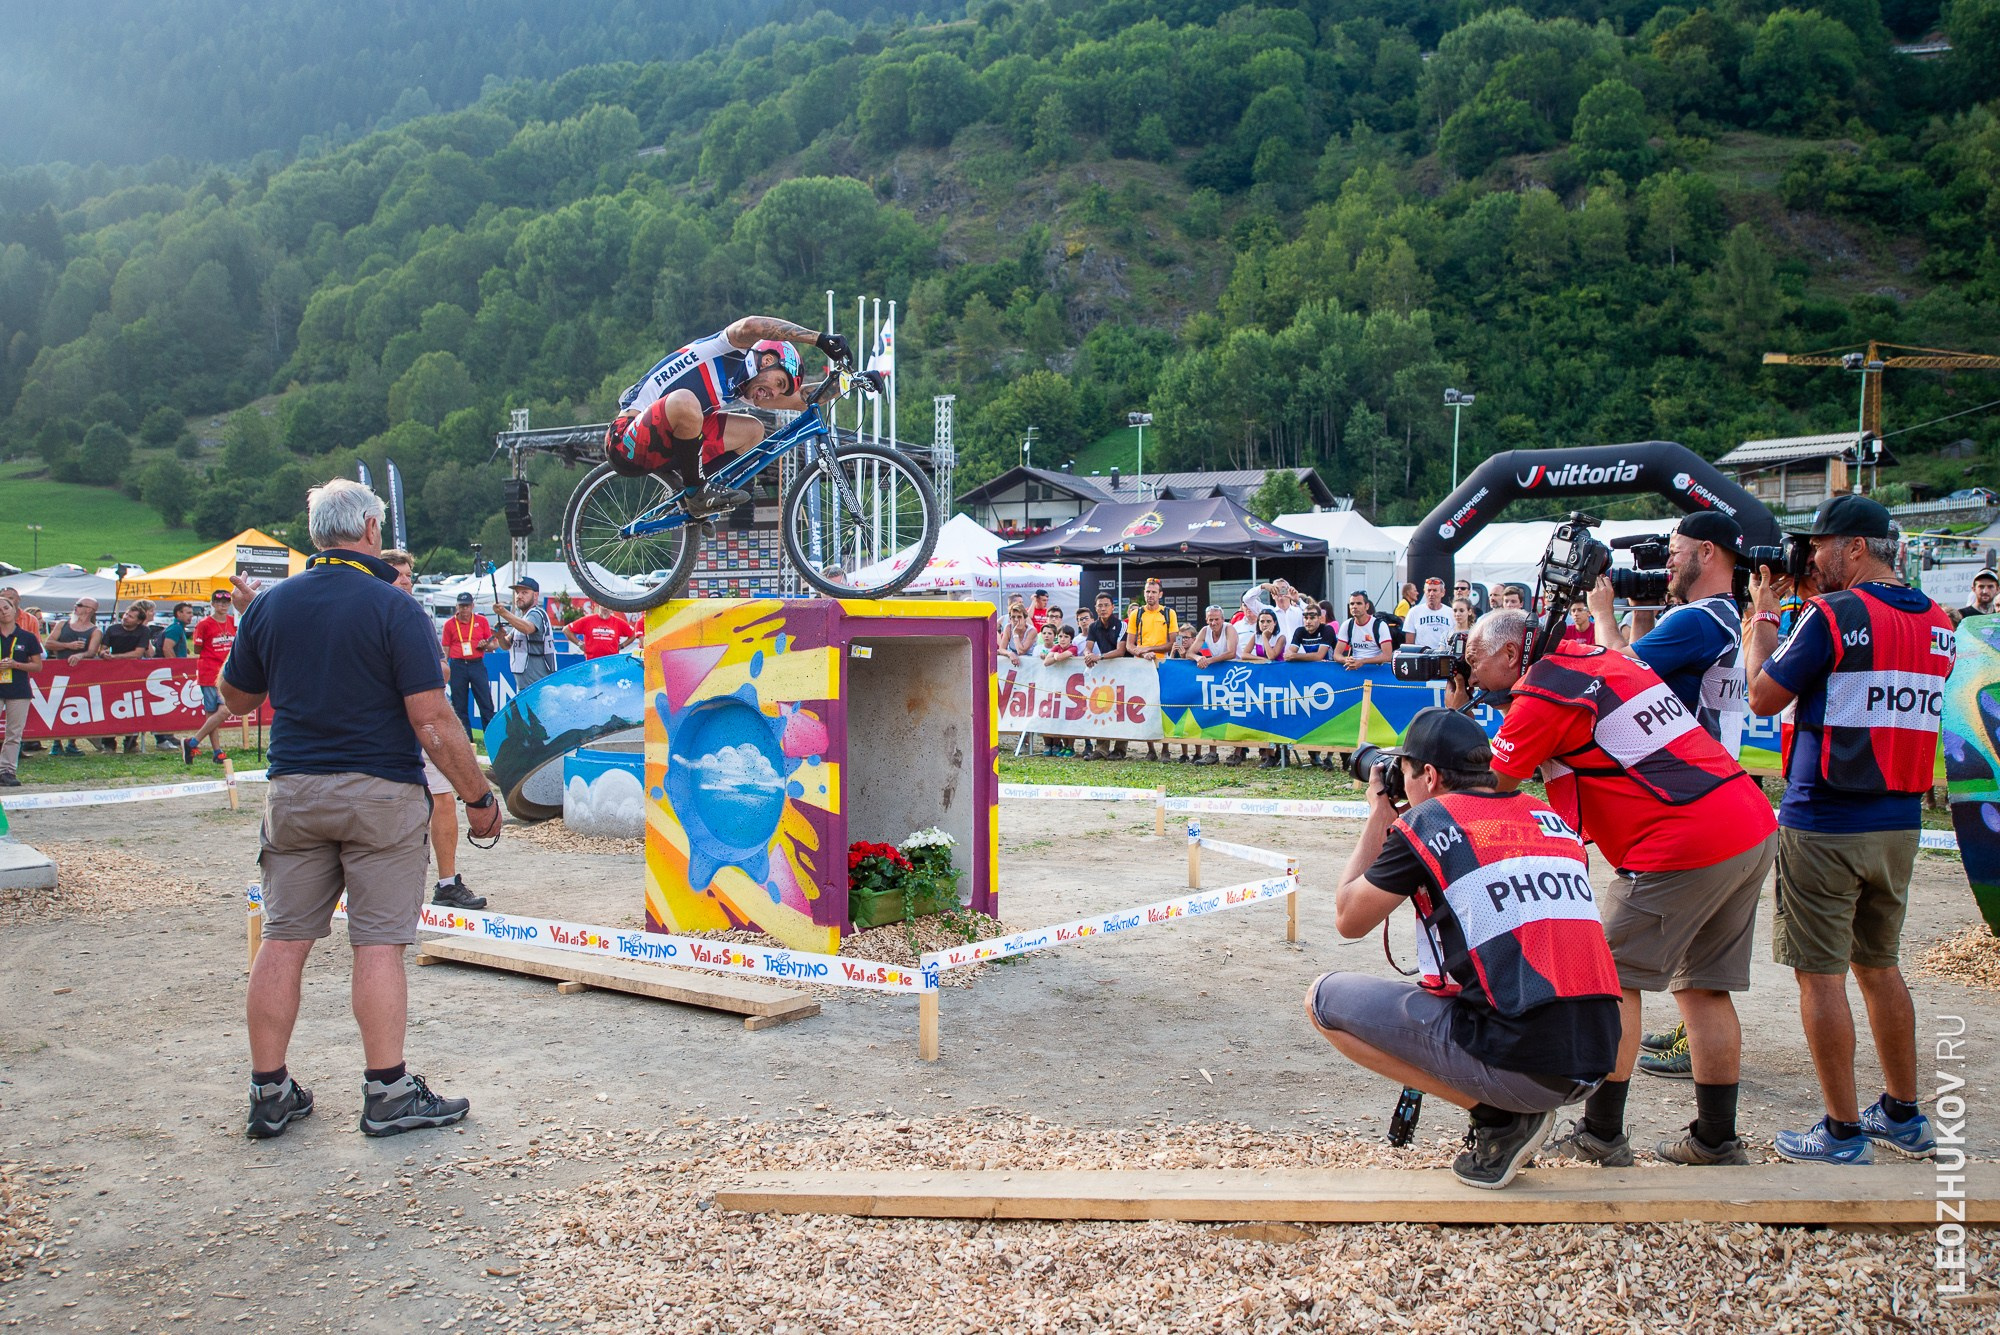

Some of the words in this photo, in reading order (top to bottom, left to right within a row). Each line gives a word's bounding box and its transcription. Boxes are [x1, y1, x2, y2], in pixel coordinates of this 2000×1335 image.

[653, 351, 700, 388] FRANCE
[1546, 460, 1639, 487] vittoria
[1453, 486, 1489, 521] GRAPHENE
[1690, 491, 1711, 508] PLUS
[1695, 485, 1737, 517] GRAPHENE
[1459, 508, 1477, 527] PLUS
[124, 583, 152, 597] ZAETA
[171, 581, 201, 595] ZAETA
[1420, 616, 1450, 626] DIESEL
[1525, 631, 1533, 652] EOS
[29, 675, 105, 730] Val
[110, 690, 145, 719] di
[998, 669, 1035, 719] Val
[1038, 691, 1061, 719] di
[1065, 673, 1147, 724] Sole
[1195, 675, 1335, 719] TRENTINO
[1866, 685, 1943, 717] PHOTO
[1633, 694, 1689, 736] PHOT
[1428, 825, 1463, 857] 104
[1485, 872, 1593, 913] PHOTO
[1104, 916, 1140, 932] TRENTINO
[1148, 909, 1159, 923] Val
[1165, 905, 1182, 919] Sole
[421, 909, 438, 927] Val
[439, 918, 447, 928] di
[447, 913, 475, 931] Sole
[482, 918, 537, 940] TRENTINO
[549, 925, 568, 944] Val
[570, 934, 579, 945] di
[579, 930, 610, 949] Sole
[617, 935, 677, 958] TRENTINO
[690, 943, 710, 962] Val
[713, 954, 722, 964] di
[722, 949, 755, 969] Sole
[763, 954, 828, 979] TRENTINO
[842, 963, 864, 981] Val
[867, 972, 876, 983] di
[877, 967, 912, 987] Sole
